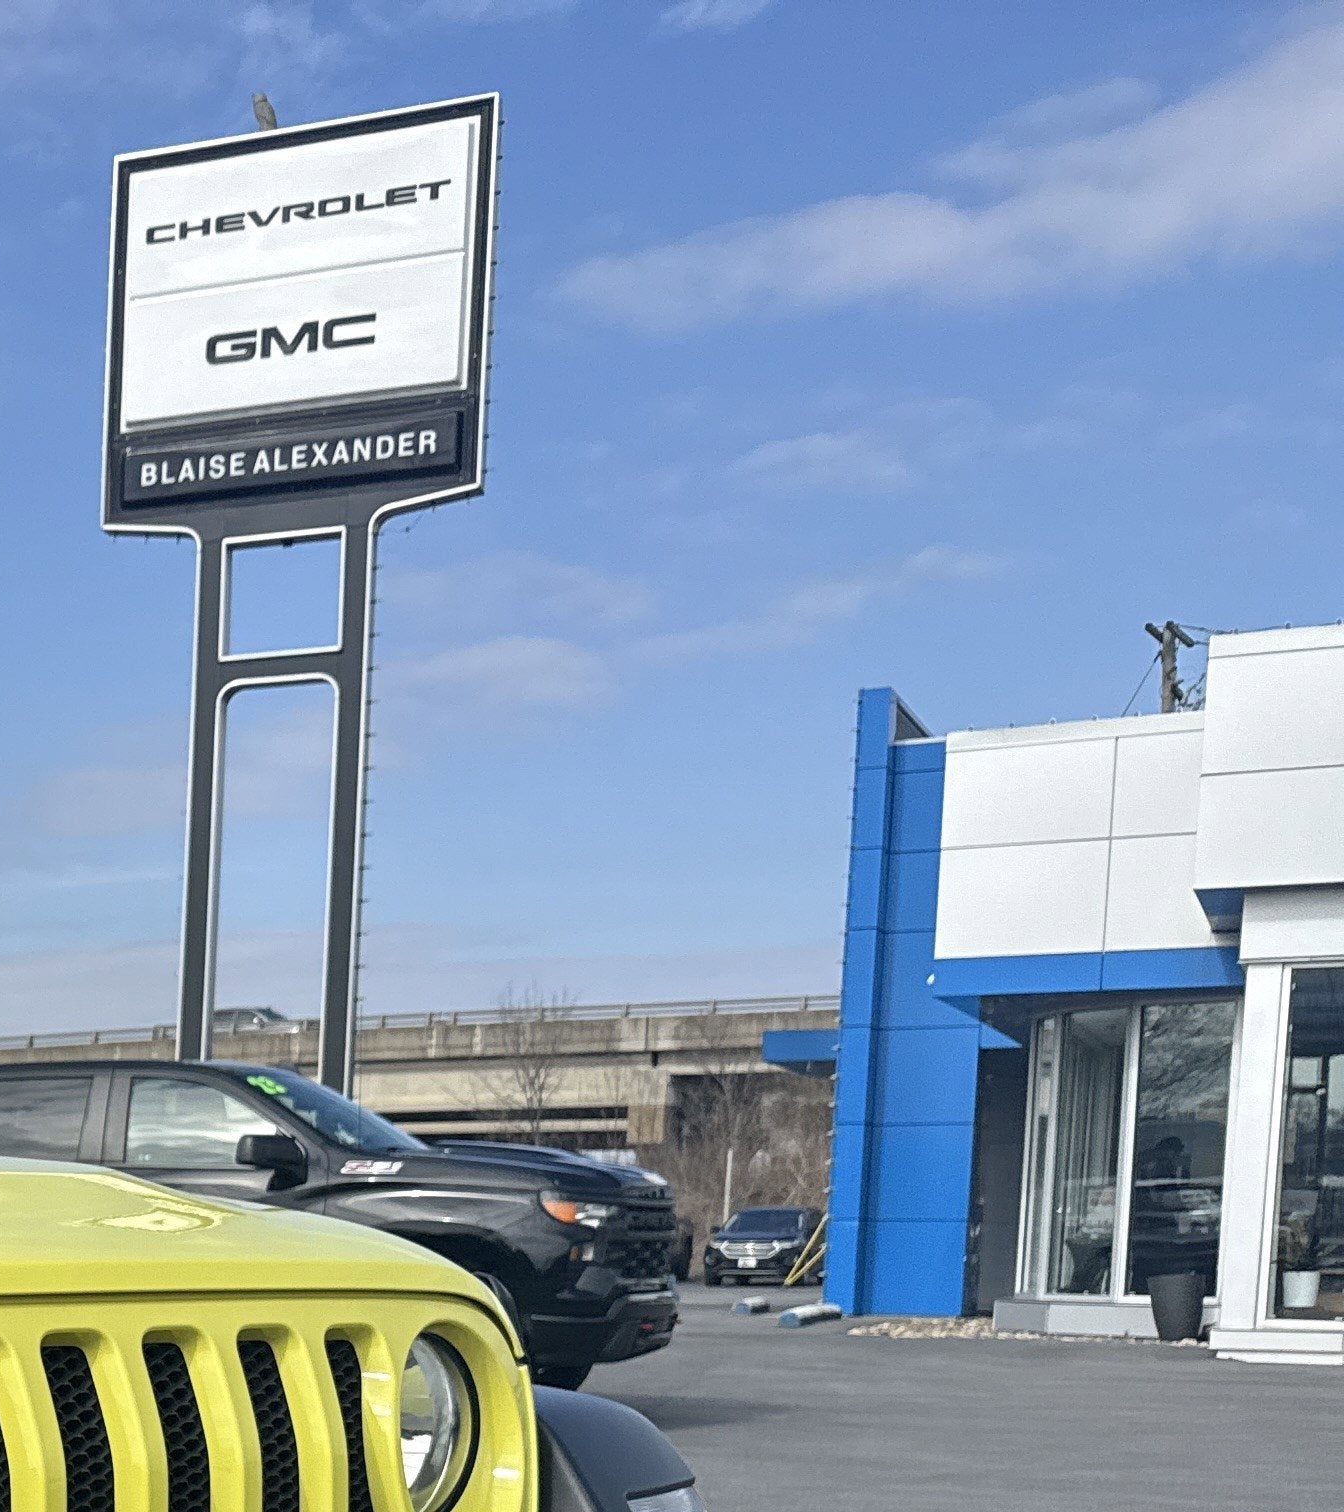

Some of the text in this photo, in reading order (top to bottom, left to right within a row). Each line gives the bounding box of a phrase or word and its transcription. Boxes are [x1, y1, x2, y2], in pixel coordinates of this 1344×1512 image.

[145, 178, 452, 245] CHEVROLET
[204, 313, 377, 365] GMC
[140, 429, 437, 488] BLAISE ALEXANDER
